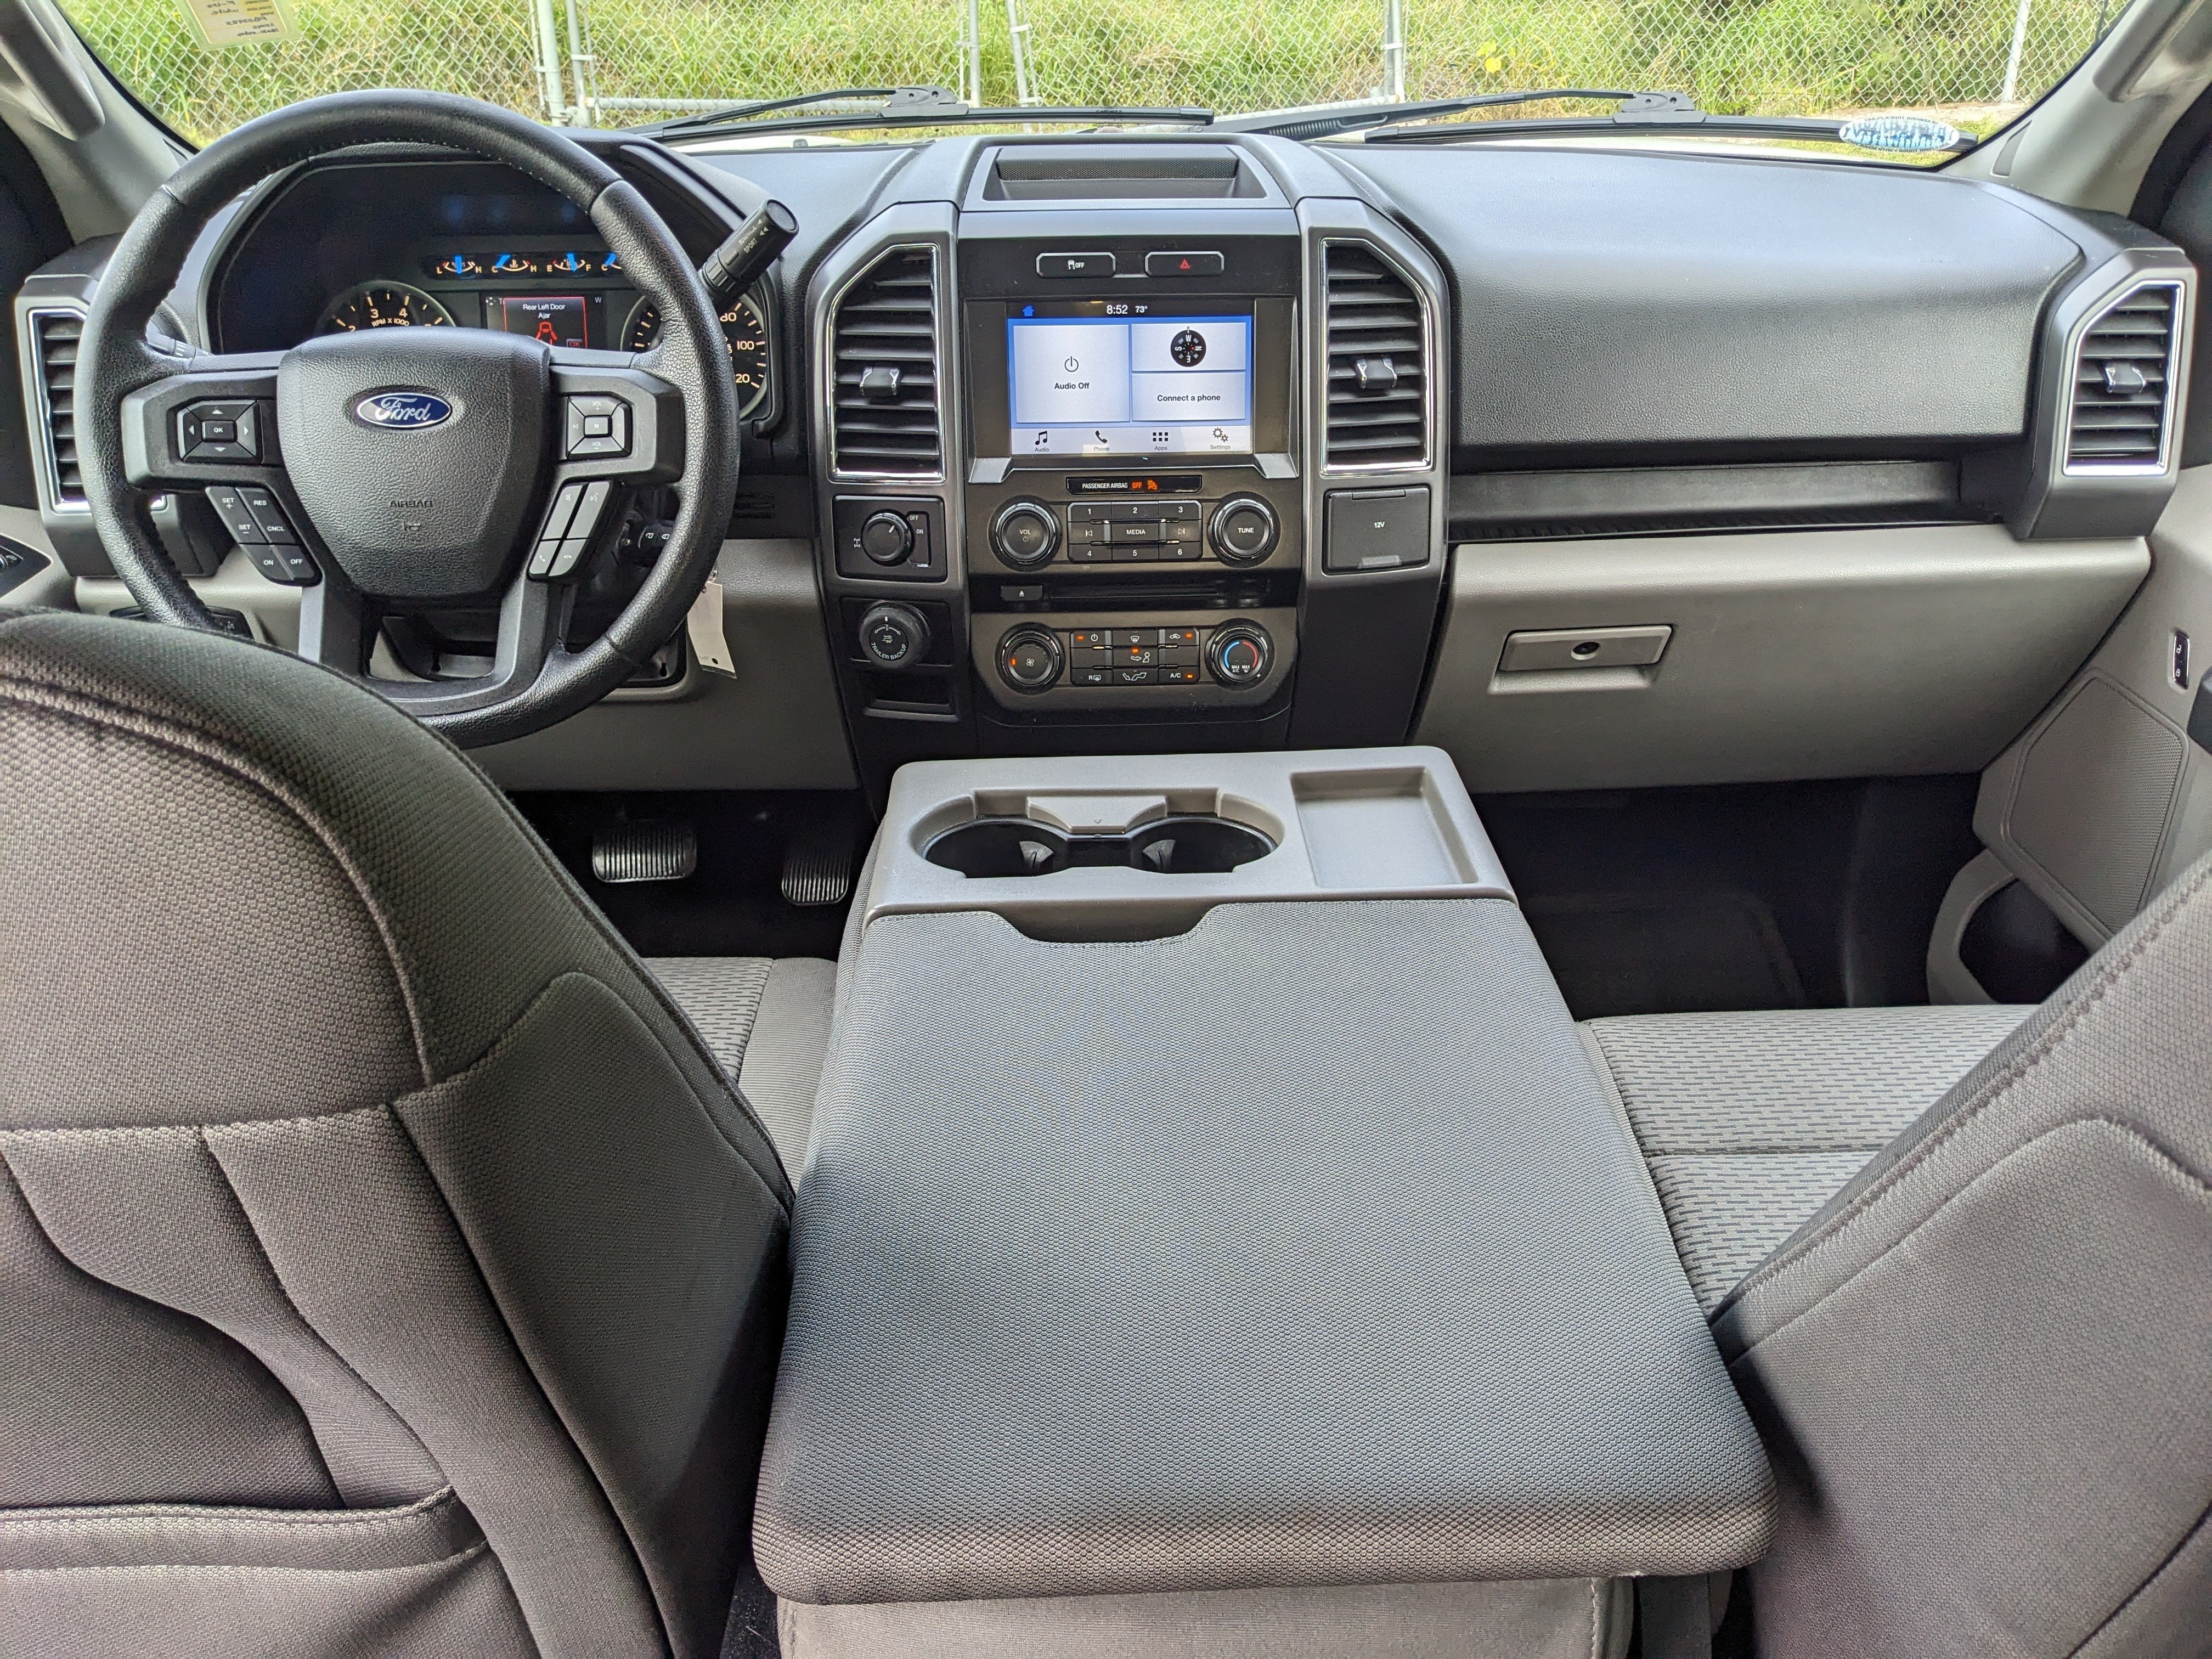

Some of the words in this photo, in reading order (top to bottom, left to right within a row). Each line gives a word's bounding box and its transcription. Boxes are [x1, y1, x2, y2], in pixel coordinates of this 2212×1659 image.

[744, 237, 757, 253] SPORT
[370, 309, 379, 318] 3
[398, 307, 408, 318] 4
[1107, 304, 1128, 314] 8:52
[372, 318, 386, 327] RPM
[394, 316, 409, 327] 1000
[737, 341, 754, 350] 100
[735, 374, 750, 383] 20
[1197, 394, 1221, 403] phone
[375, 397, 431, 420] Ford
[871, 642, 889, 659] TRAILER
[890, 644, 906, 660] BACKUP
